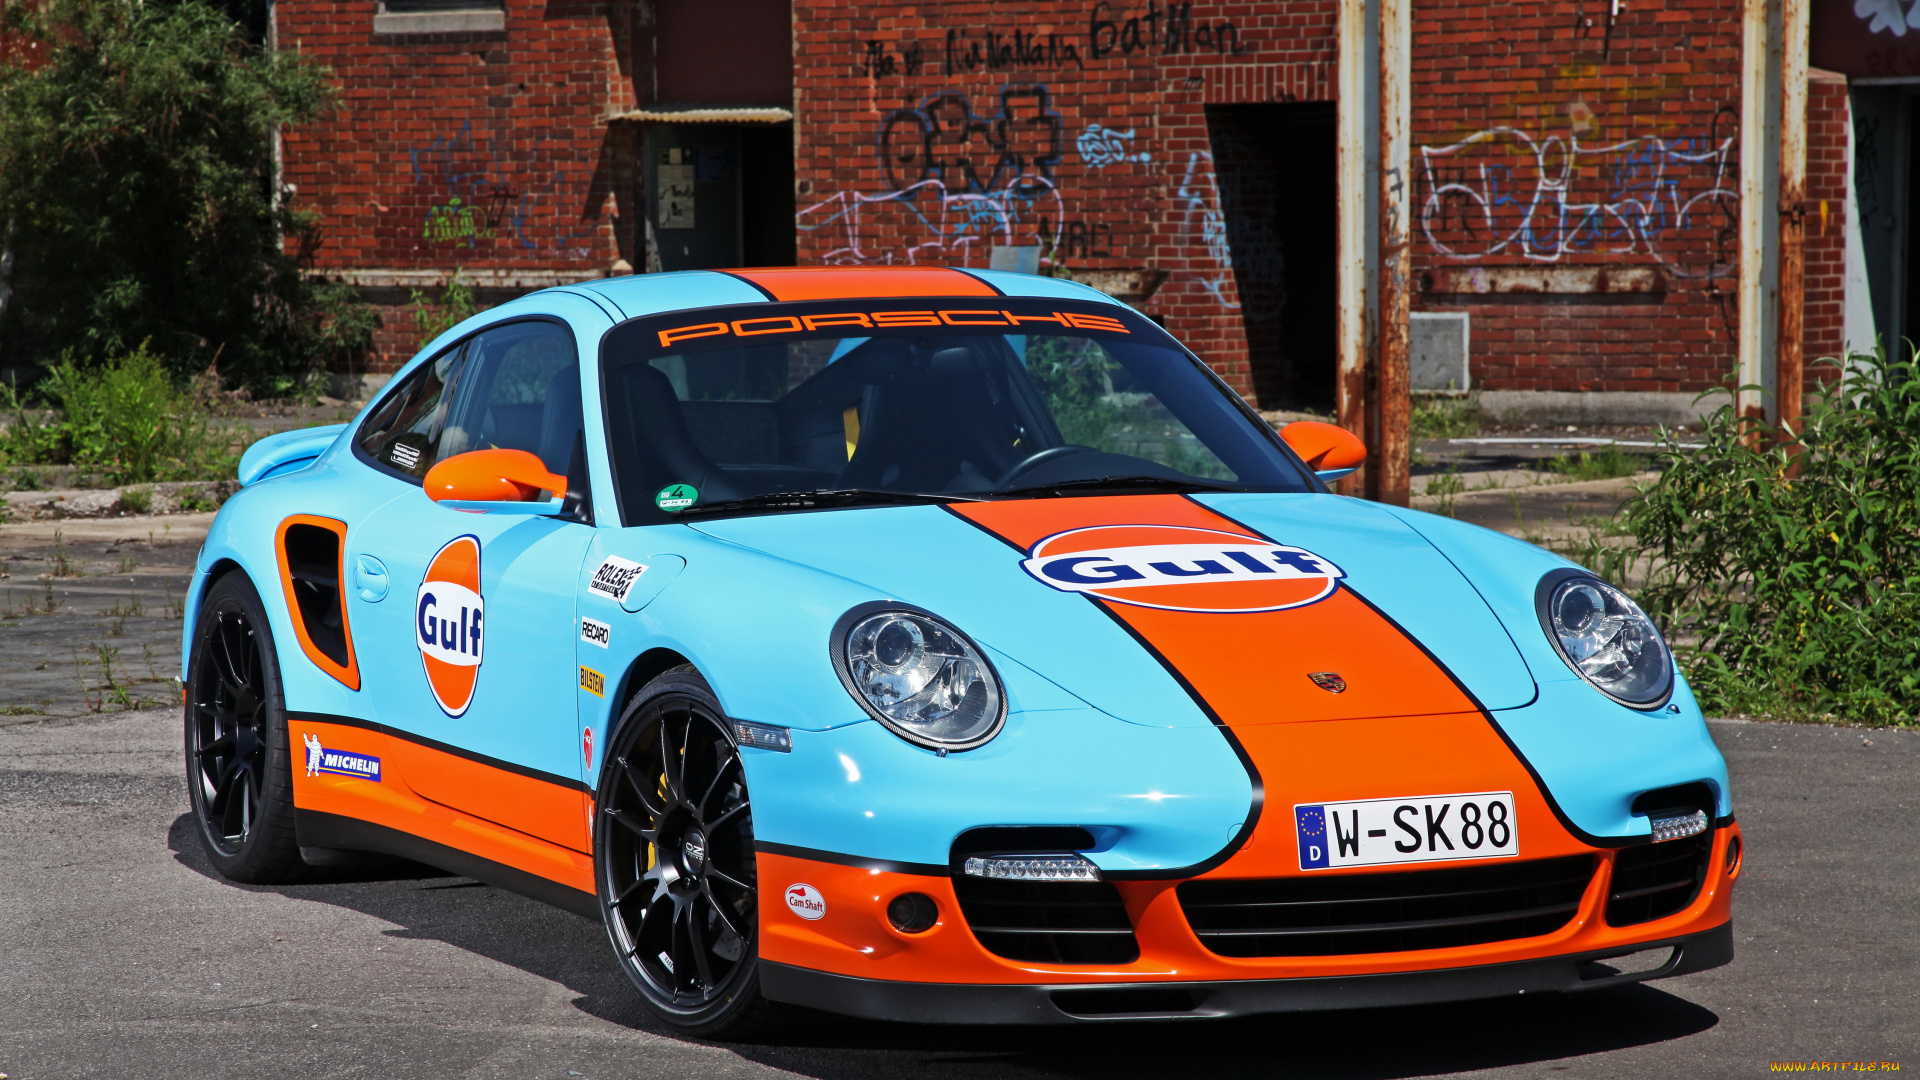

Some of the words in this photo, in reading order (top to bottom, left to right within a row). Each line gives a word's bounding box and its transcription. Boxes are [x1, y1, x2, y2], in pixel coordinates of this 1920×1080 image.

[658, 310, 1130, 348] PORSCHE
[671, 485, 684, 499] 4
[594, 563, 628, 586] ROLEX
[1041, 551, 1325, 584] Gulf
[418, 592, 482, 657] Gulf
[582, 621, 609, 645] RECARO
[581, 668, 605, 696] BILSTEIN
[324, 754, 379, 774] MICHELIN
[1309, 845, 1322, 861] D
[1332, 801, 1511, 857] W-SK88
[789, 896, 804, 908] Cam
[805, 899, 823, 912] Shaft
